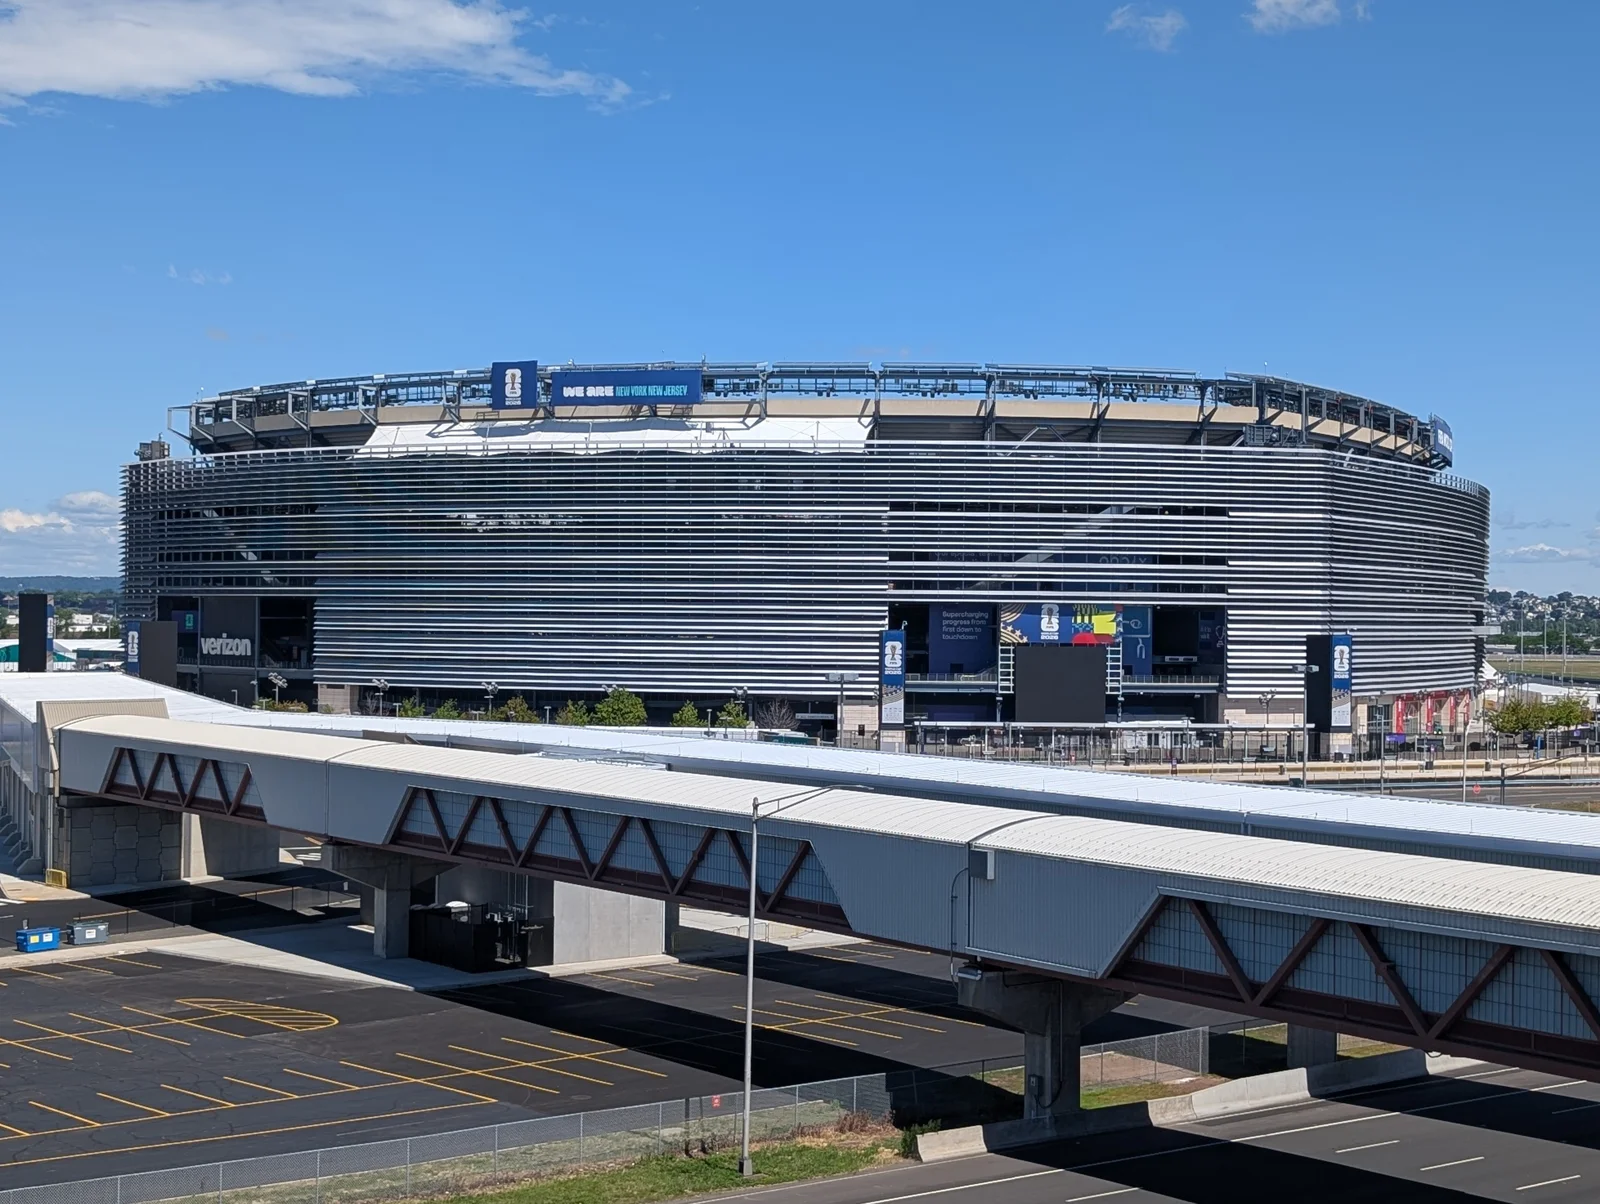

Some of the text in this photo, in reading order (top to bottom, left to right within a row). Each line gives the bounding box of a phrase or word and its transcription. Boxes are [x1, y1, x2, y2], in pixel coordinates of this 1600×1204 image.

[563, 386, 584, 397] WE
[586, 386, 614, 396] ARE
[616, 386, 631, 396] NEW
[631, 386, 648, 396] YORK
[648, 386, 664, 396] NEW
[942, 610, 988, 619] Supercharging
[200, 632, 252, 656] verizon
